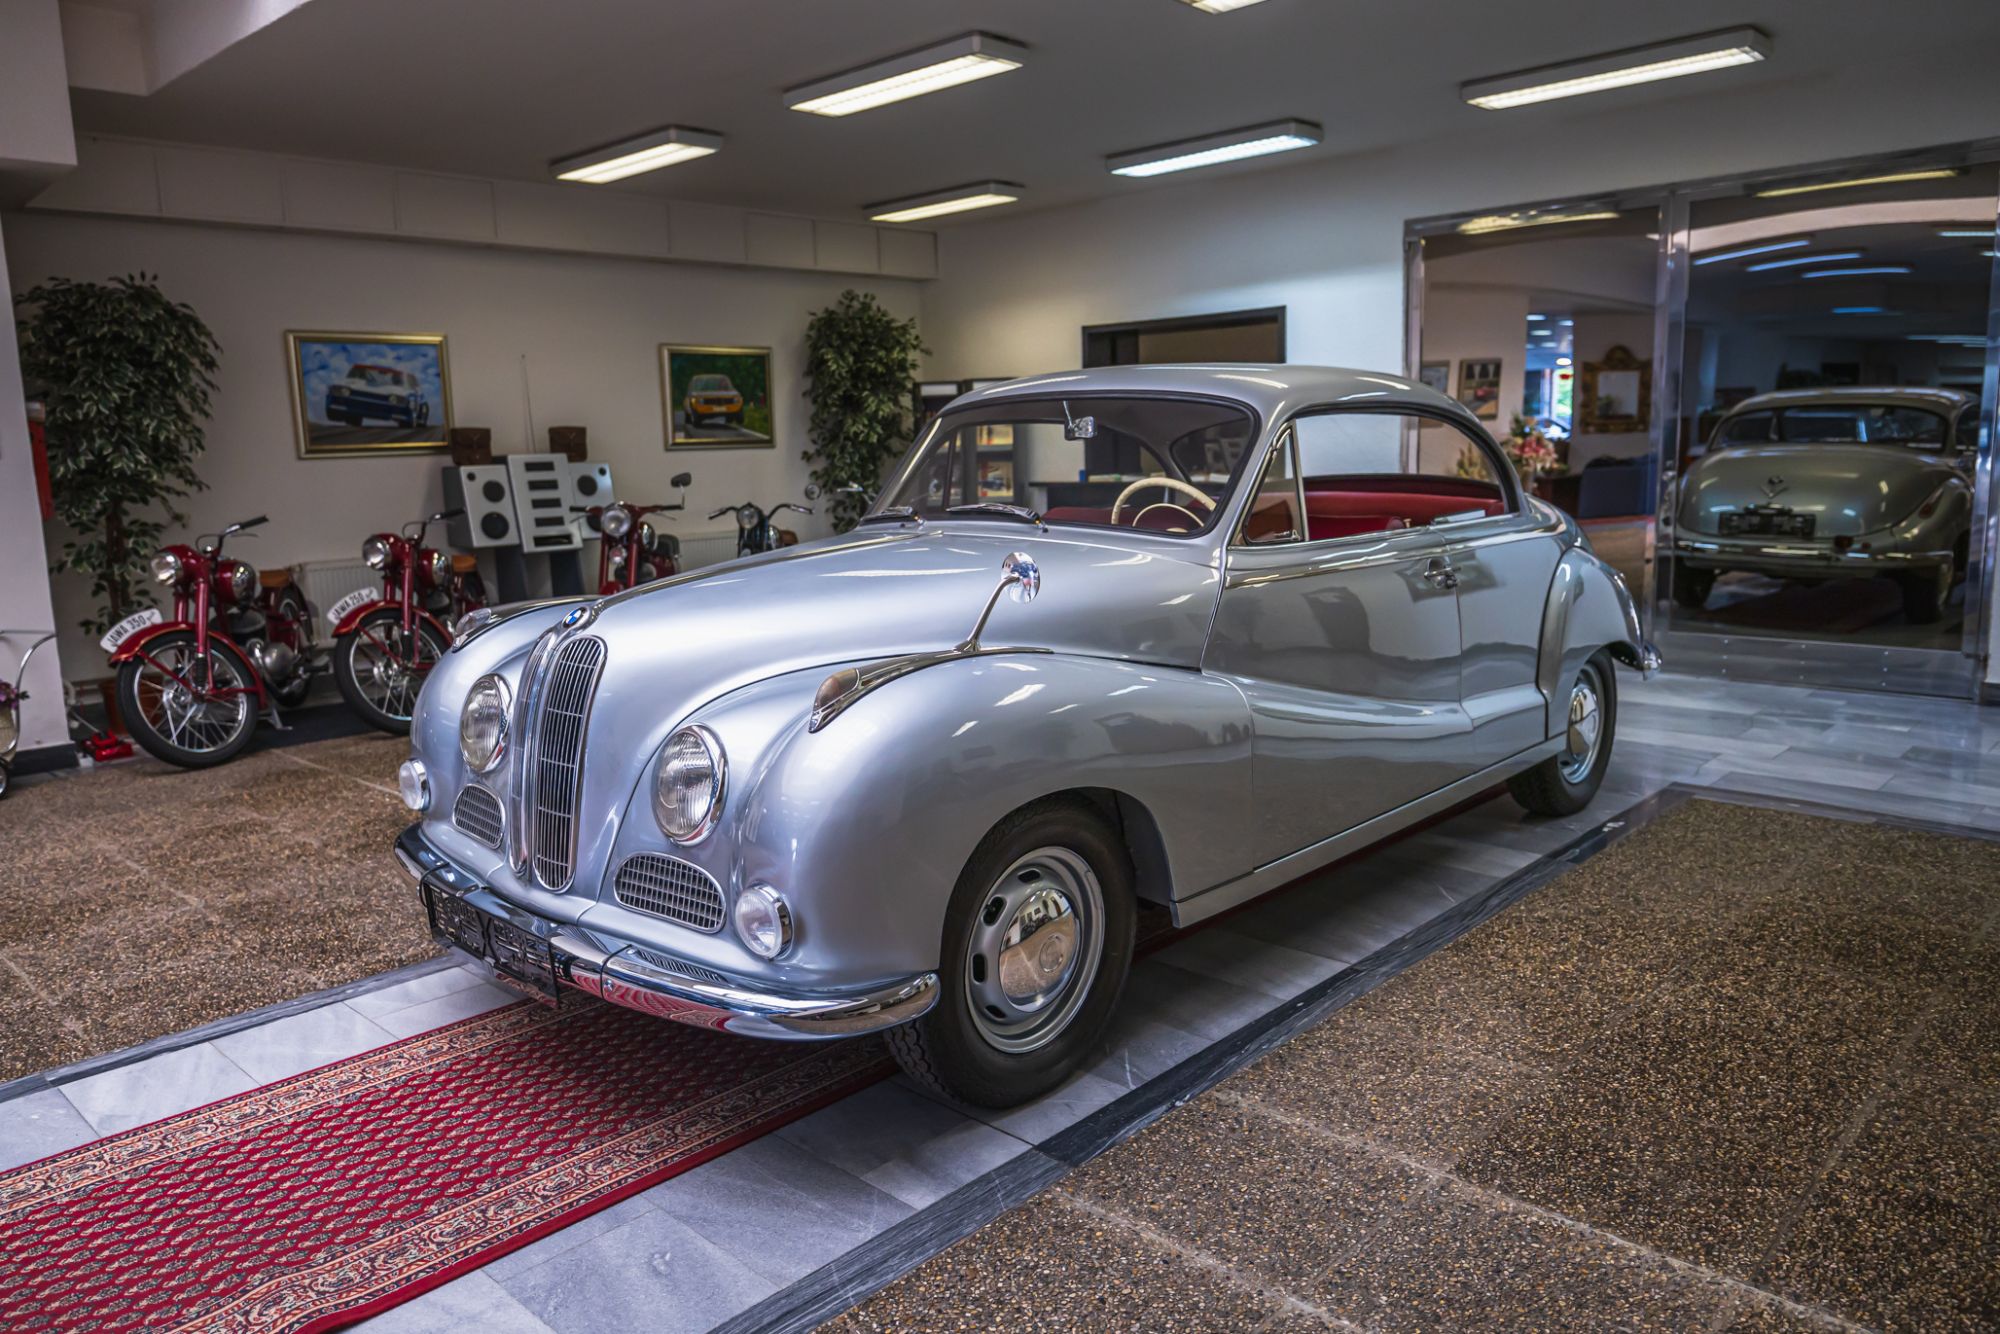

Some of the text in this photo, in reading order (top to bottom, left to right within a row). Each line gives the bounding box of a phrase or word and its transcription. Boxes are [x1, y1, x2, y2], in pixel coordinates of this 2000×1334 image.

[332, 599, 351, 620] JAWA
[349, 591, 365, 606] 250
[107, 624, 129, 647] JAWA
[126, 614, 147, 630] 350
